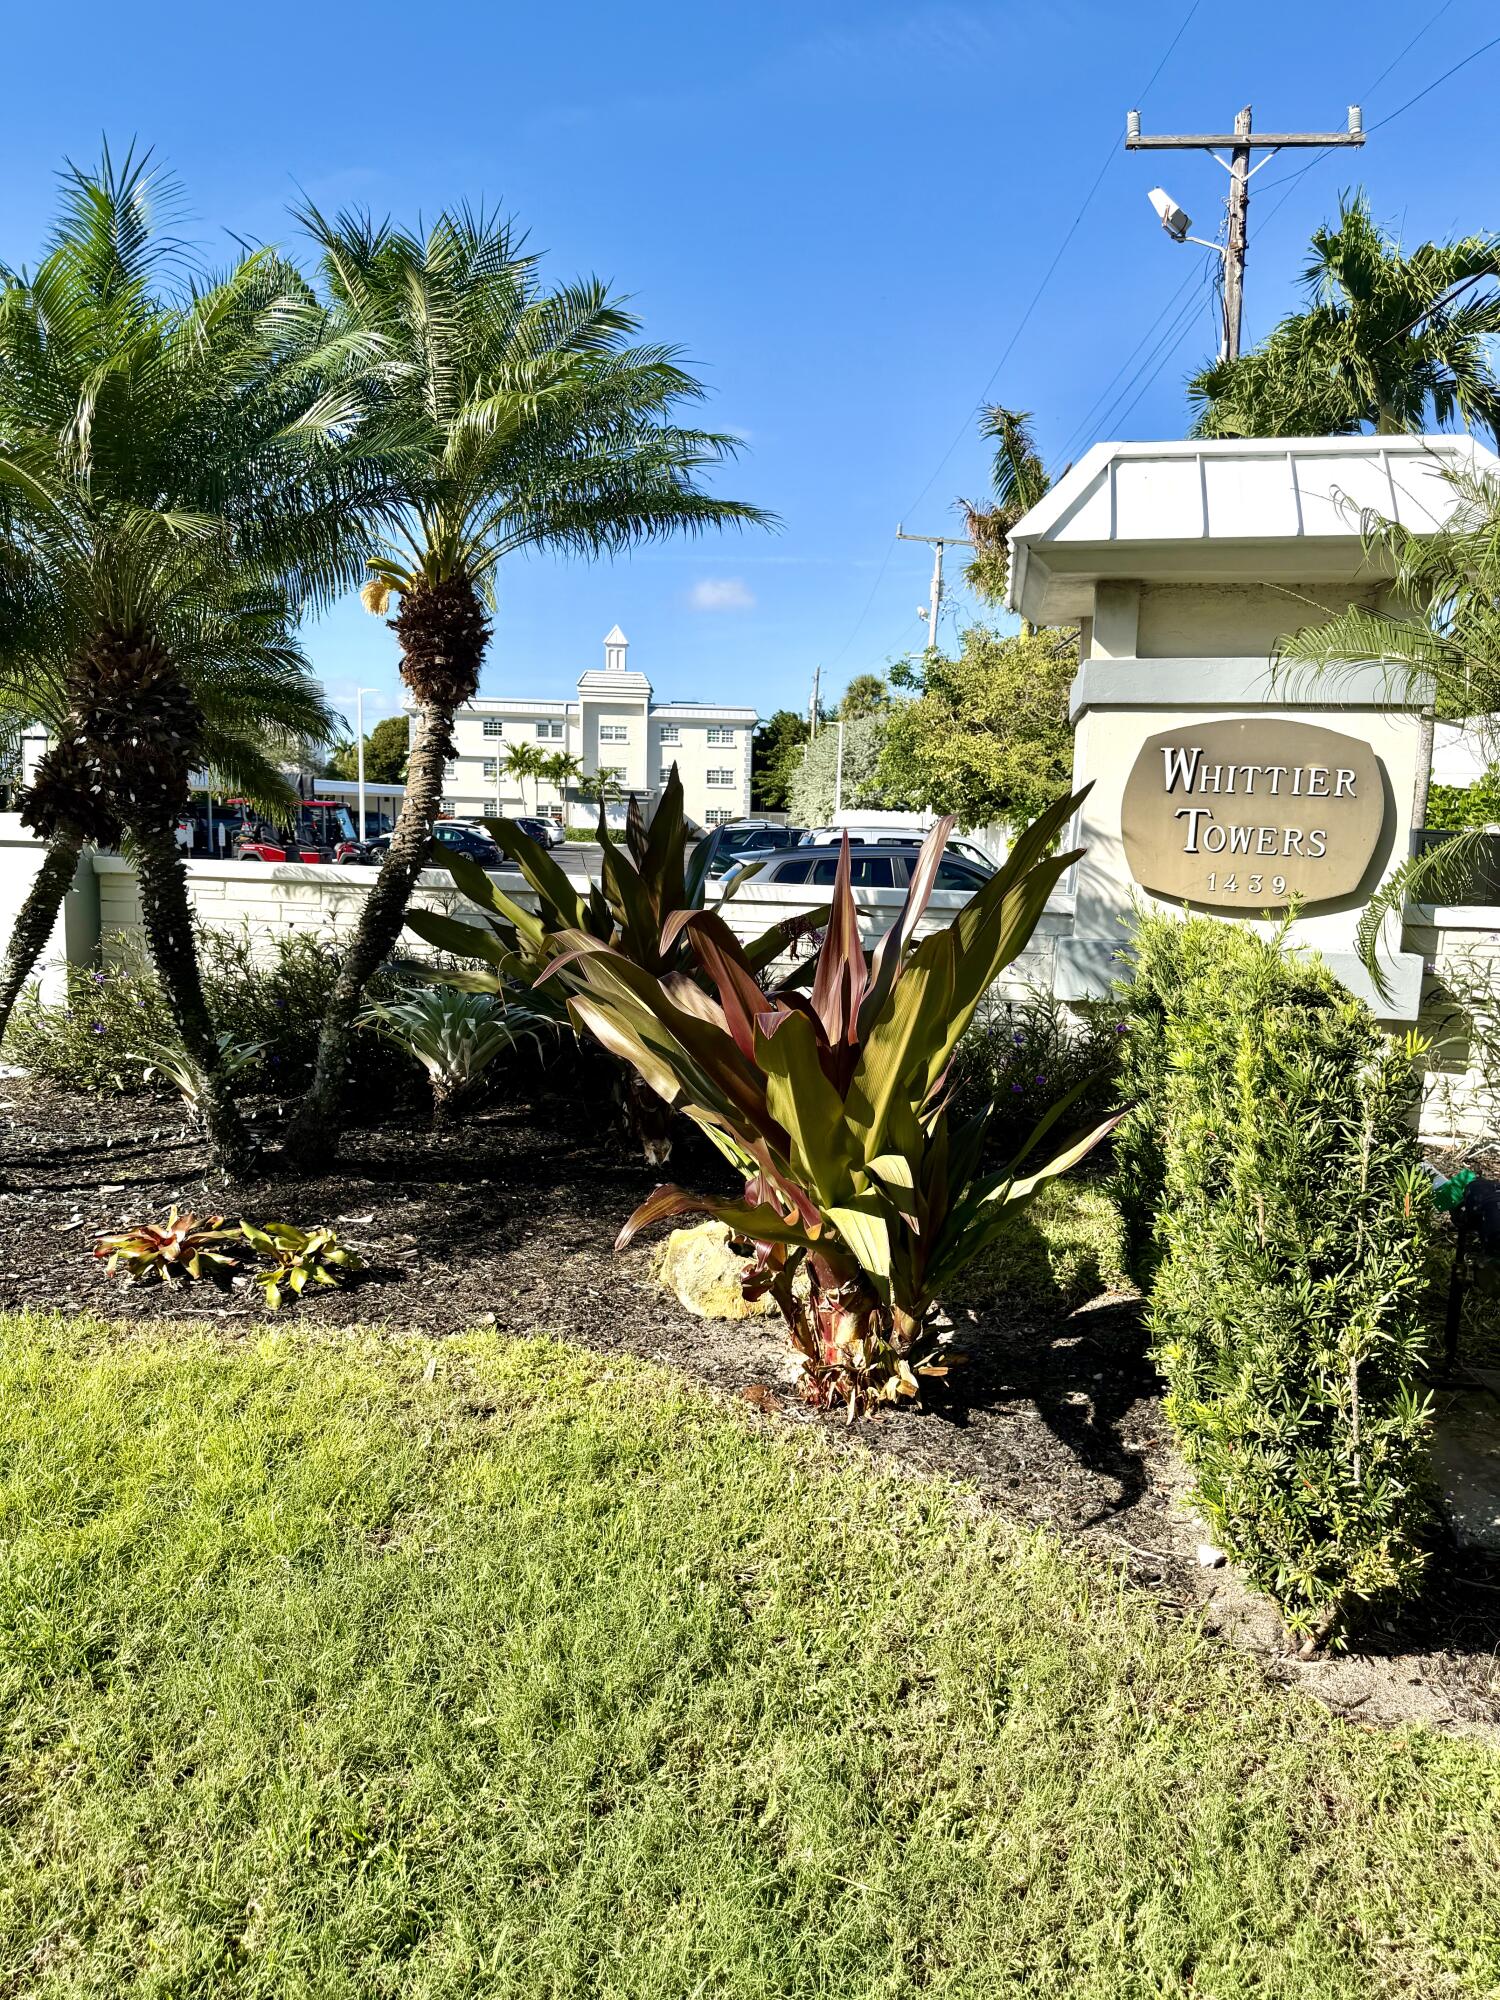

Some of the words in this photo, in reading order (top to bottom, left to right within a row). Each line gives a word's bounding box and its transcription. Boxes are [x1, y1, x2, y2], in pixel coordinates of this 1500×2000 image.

[1161, 747, 1357, 798] WHITTIER
[1174, 808, 1328, 857] TOWERS
[1207, 872, 1287, 895] 1439
